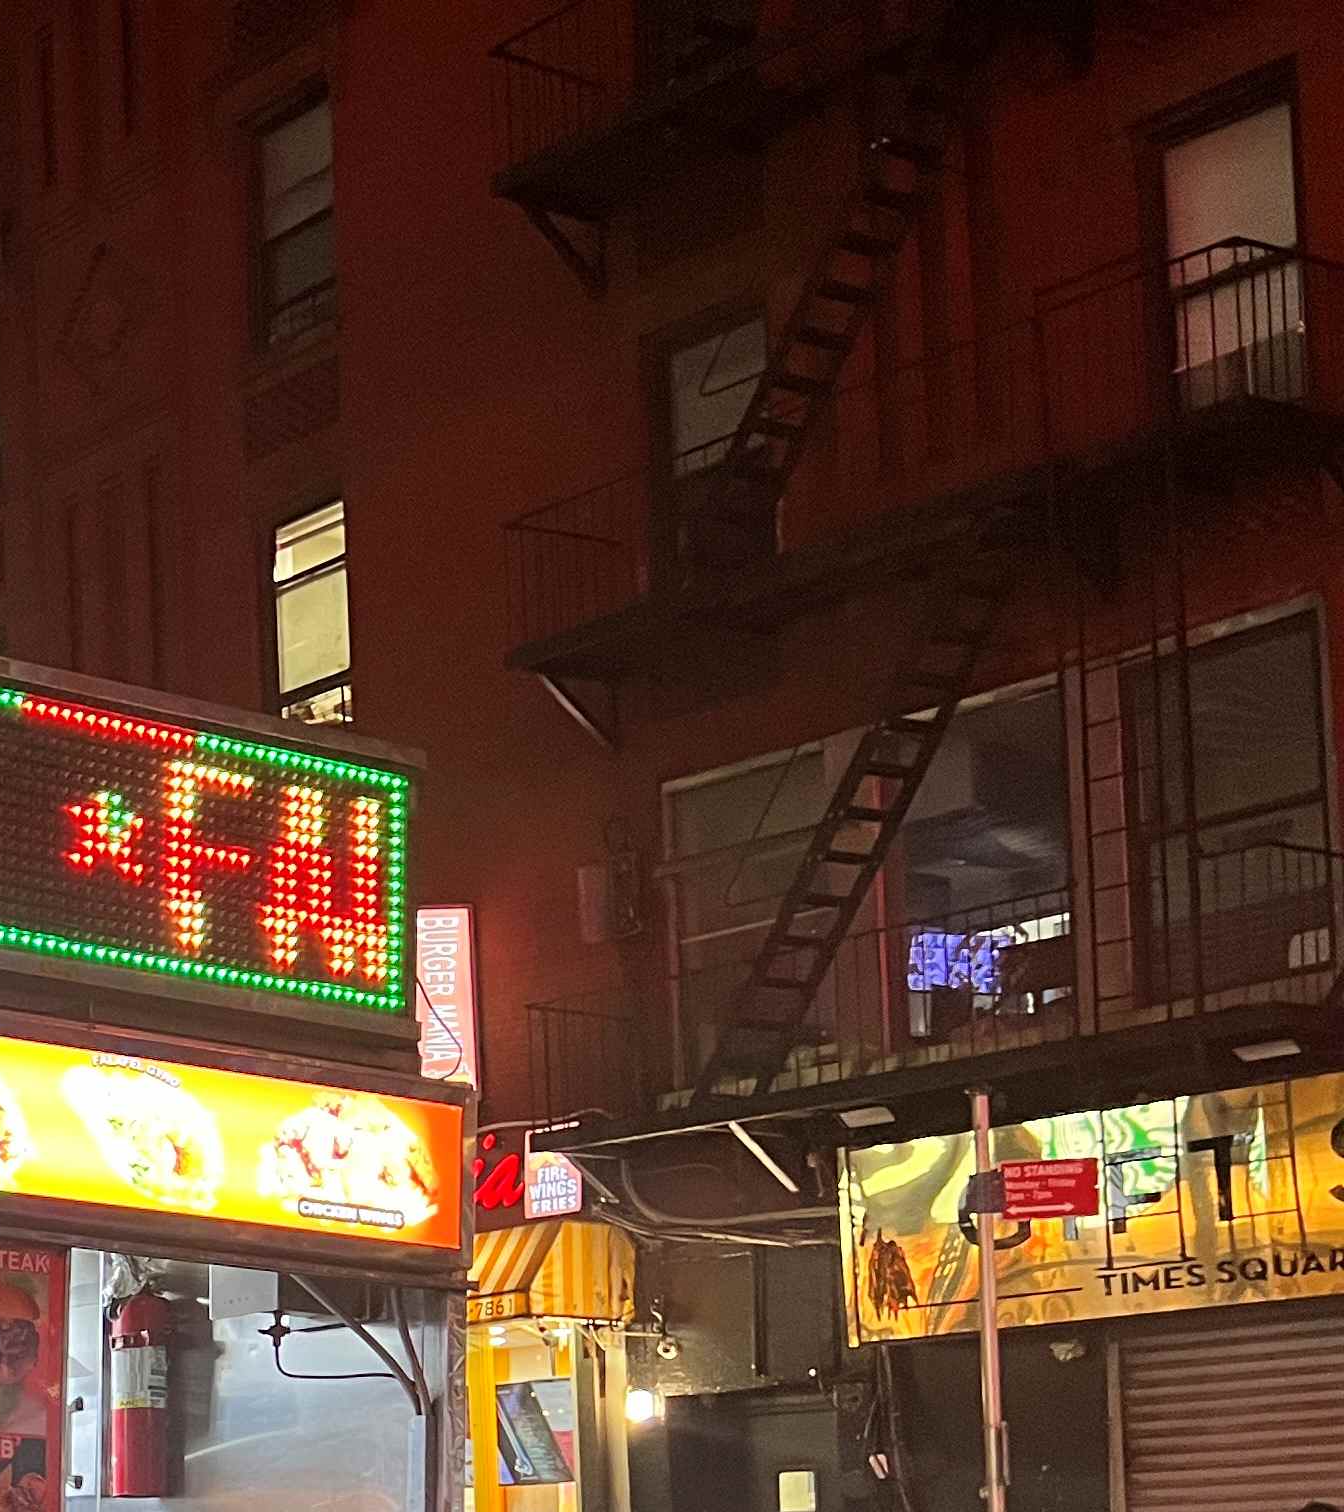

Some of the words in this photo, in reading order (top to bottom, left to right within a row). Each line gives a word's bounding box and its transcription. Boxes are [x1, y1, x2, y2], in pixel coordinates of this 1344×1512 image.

[421, 915, 459, 997] BURGER
[424, 1002, 460, 1064] MANIA
[537, 1166, 569, 1181] FIRE
[1004, 1166, 1021, 1178] NO
[529, 1179, 578, 1199] WINGS
[531, 1197, 578, 1214] FRIES
[1096, 1264, 1206, 1297] TIMES
